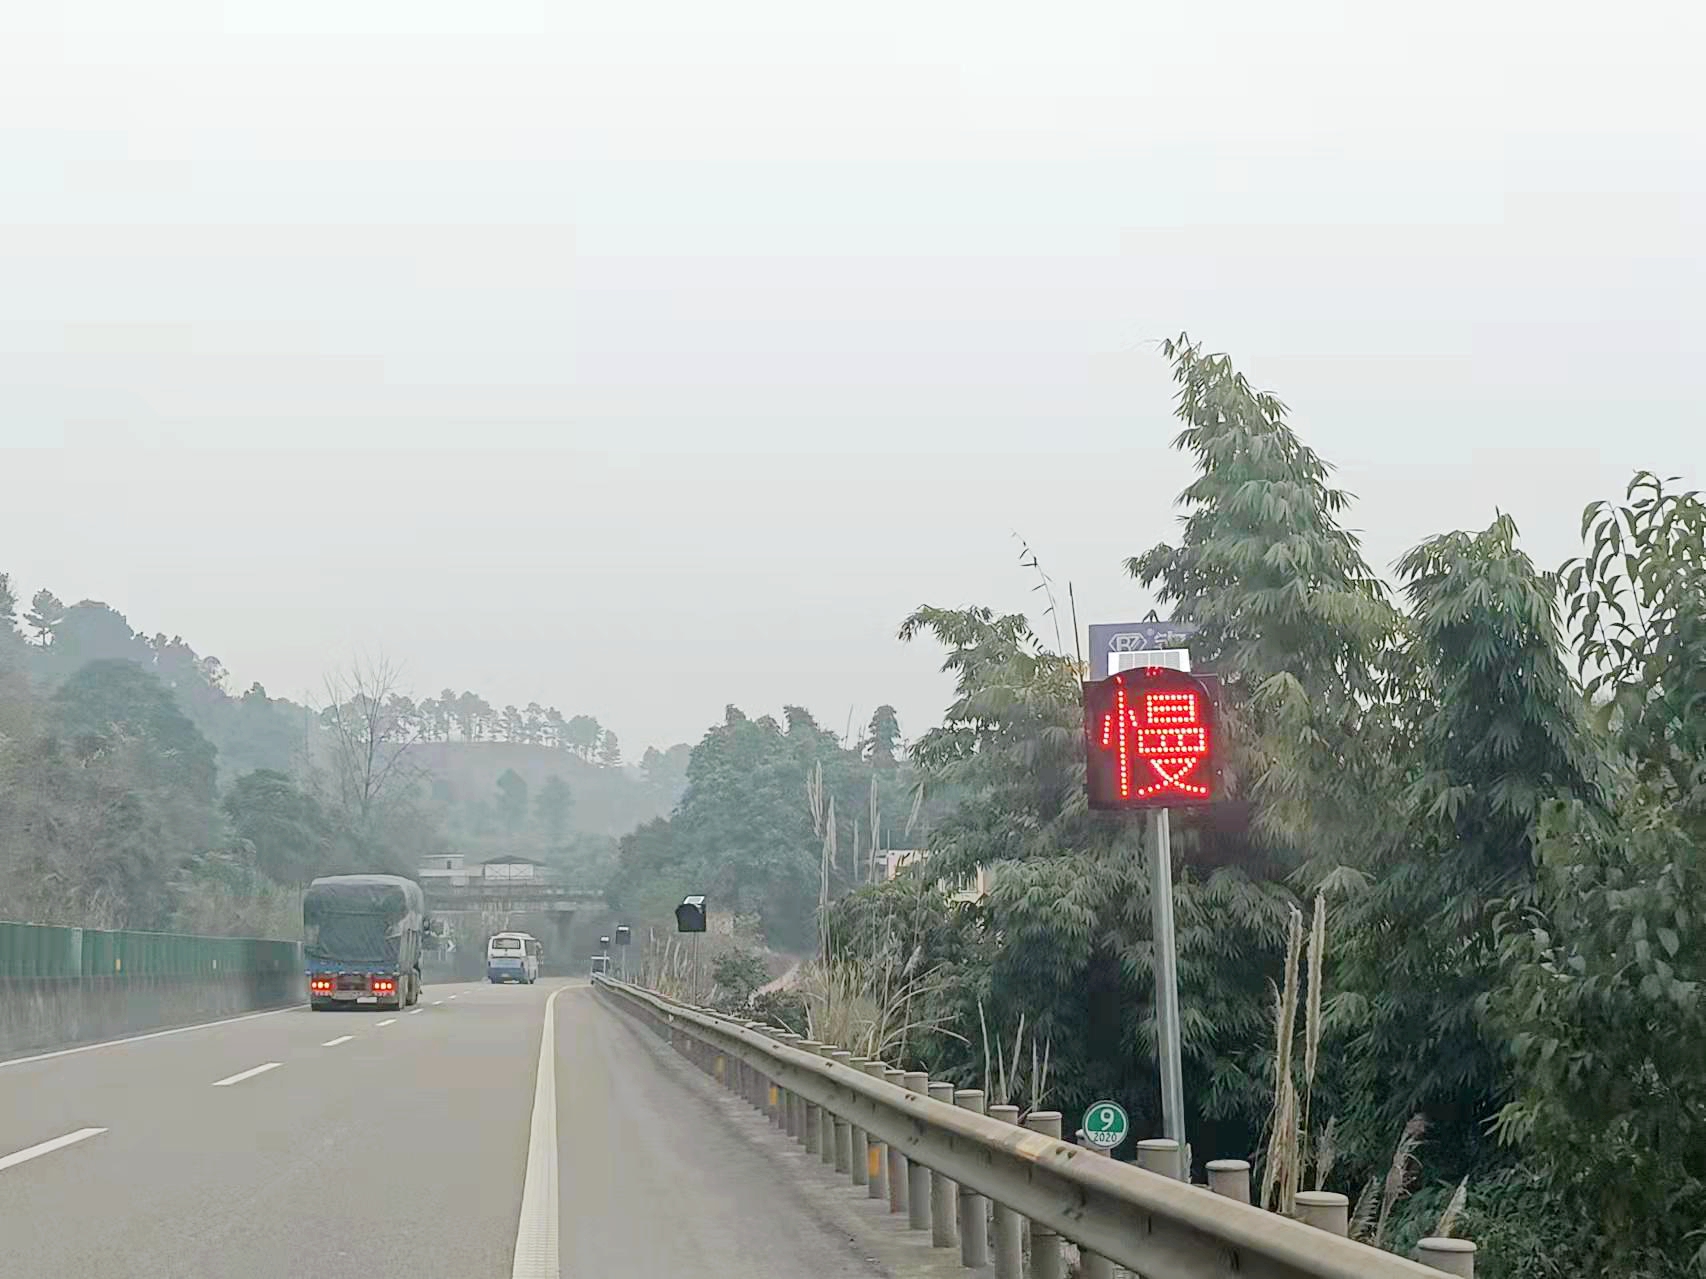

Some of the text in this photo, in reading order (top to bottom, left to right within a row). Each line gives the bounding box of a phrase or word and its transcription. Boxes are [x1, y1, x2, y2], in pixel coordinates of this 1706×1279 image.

[1102, 689, 1207, 797] 慢
[1100, 1108, 1115, 1131] 9
[1093, 1132, 1118, 1143] 2020
